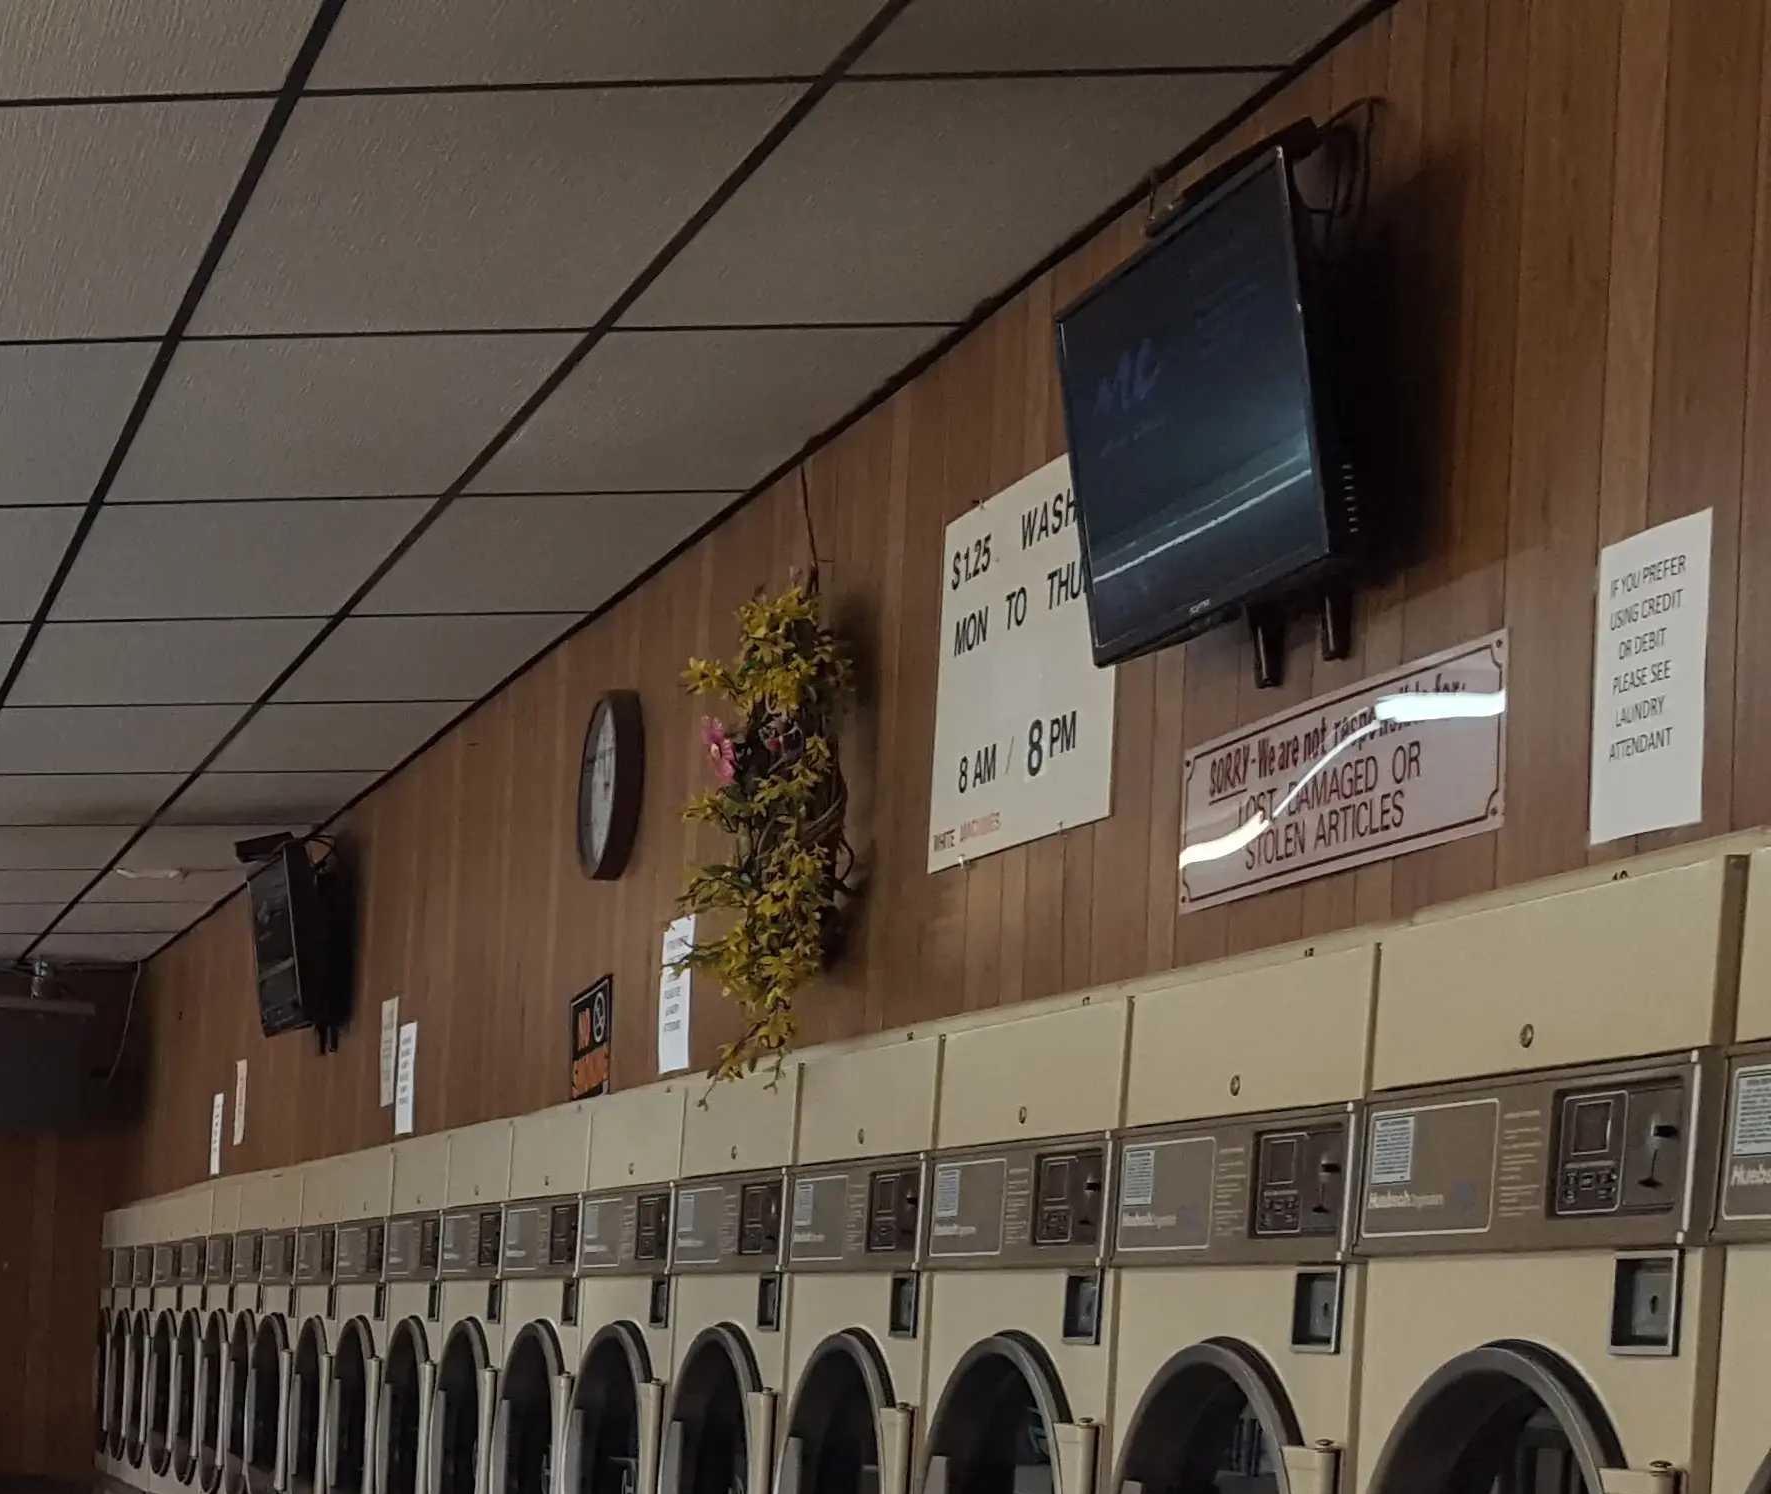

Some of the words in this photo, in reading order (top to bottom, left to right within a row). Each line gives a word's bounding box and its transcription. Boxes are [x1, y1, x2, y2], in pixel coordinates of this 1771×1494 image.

[1610, 578, 1620, 599] IF
[1621, 572, 1641, 594] YOU
[1642, 554, 1686, 586] PREFER
[954, 605, 989, 658] MON
[1005, 586, 1027, 631] TO
[1610, 603, 1640, 632] USING
[1641, 588, 1684, 619] CREDIT
[1618, 638, 1632, 661] OR
[1634, 627, 1667, 656] DEBIT
[1612, 666, 1647, 695] PLEASE
[1650, 660, 1671, 682] SEE
[1615, 695, 1665, 728] LAUNDRY
[958, 755, 968, 794] 8
[972, 743, 997, 788] AM
[1027, 719, 1043, 777] 8
[1050, 710, 1077, 759] PM
[1278, 735, 1299, 771] are
[1303, 717, 1327, 763] not
[1609, 727, 1673, 762] ATTENDANT
[1288, 756, 1378, 816] DAMAGED
[1392, 740, 1421, 785] OR
[1245, 819, 1306, 870] STOLEN
[1315, 790, 1405, 850] ARTICLES
